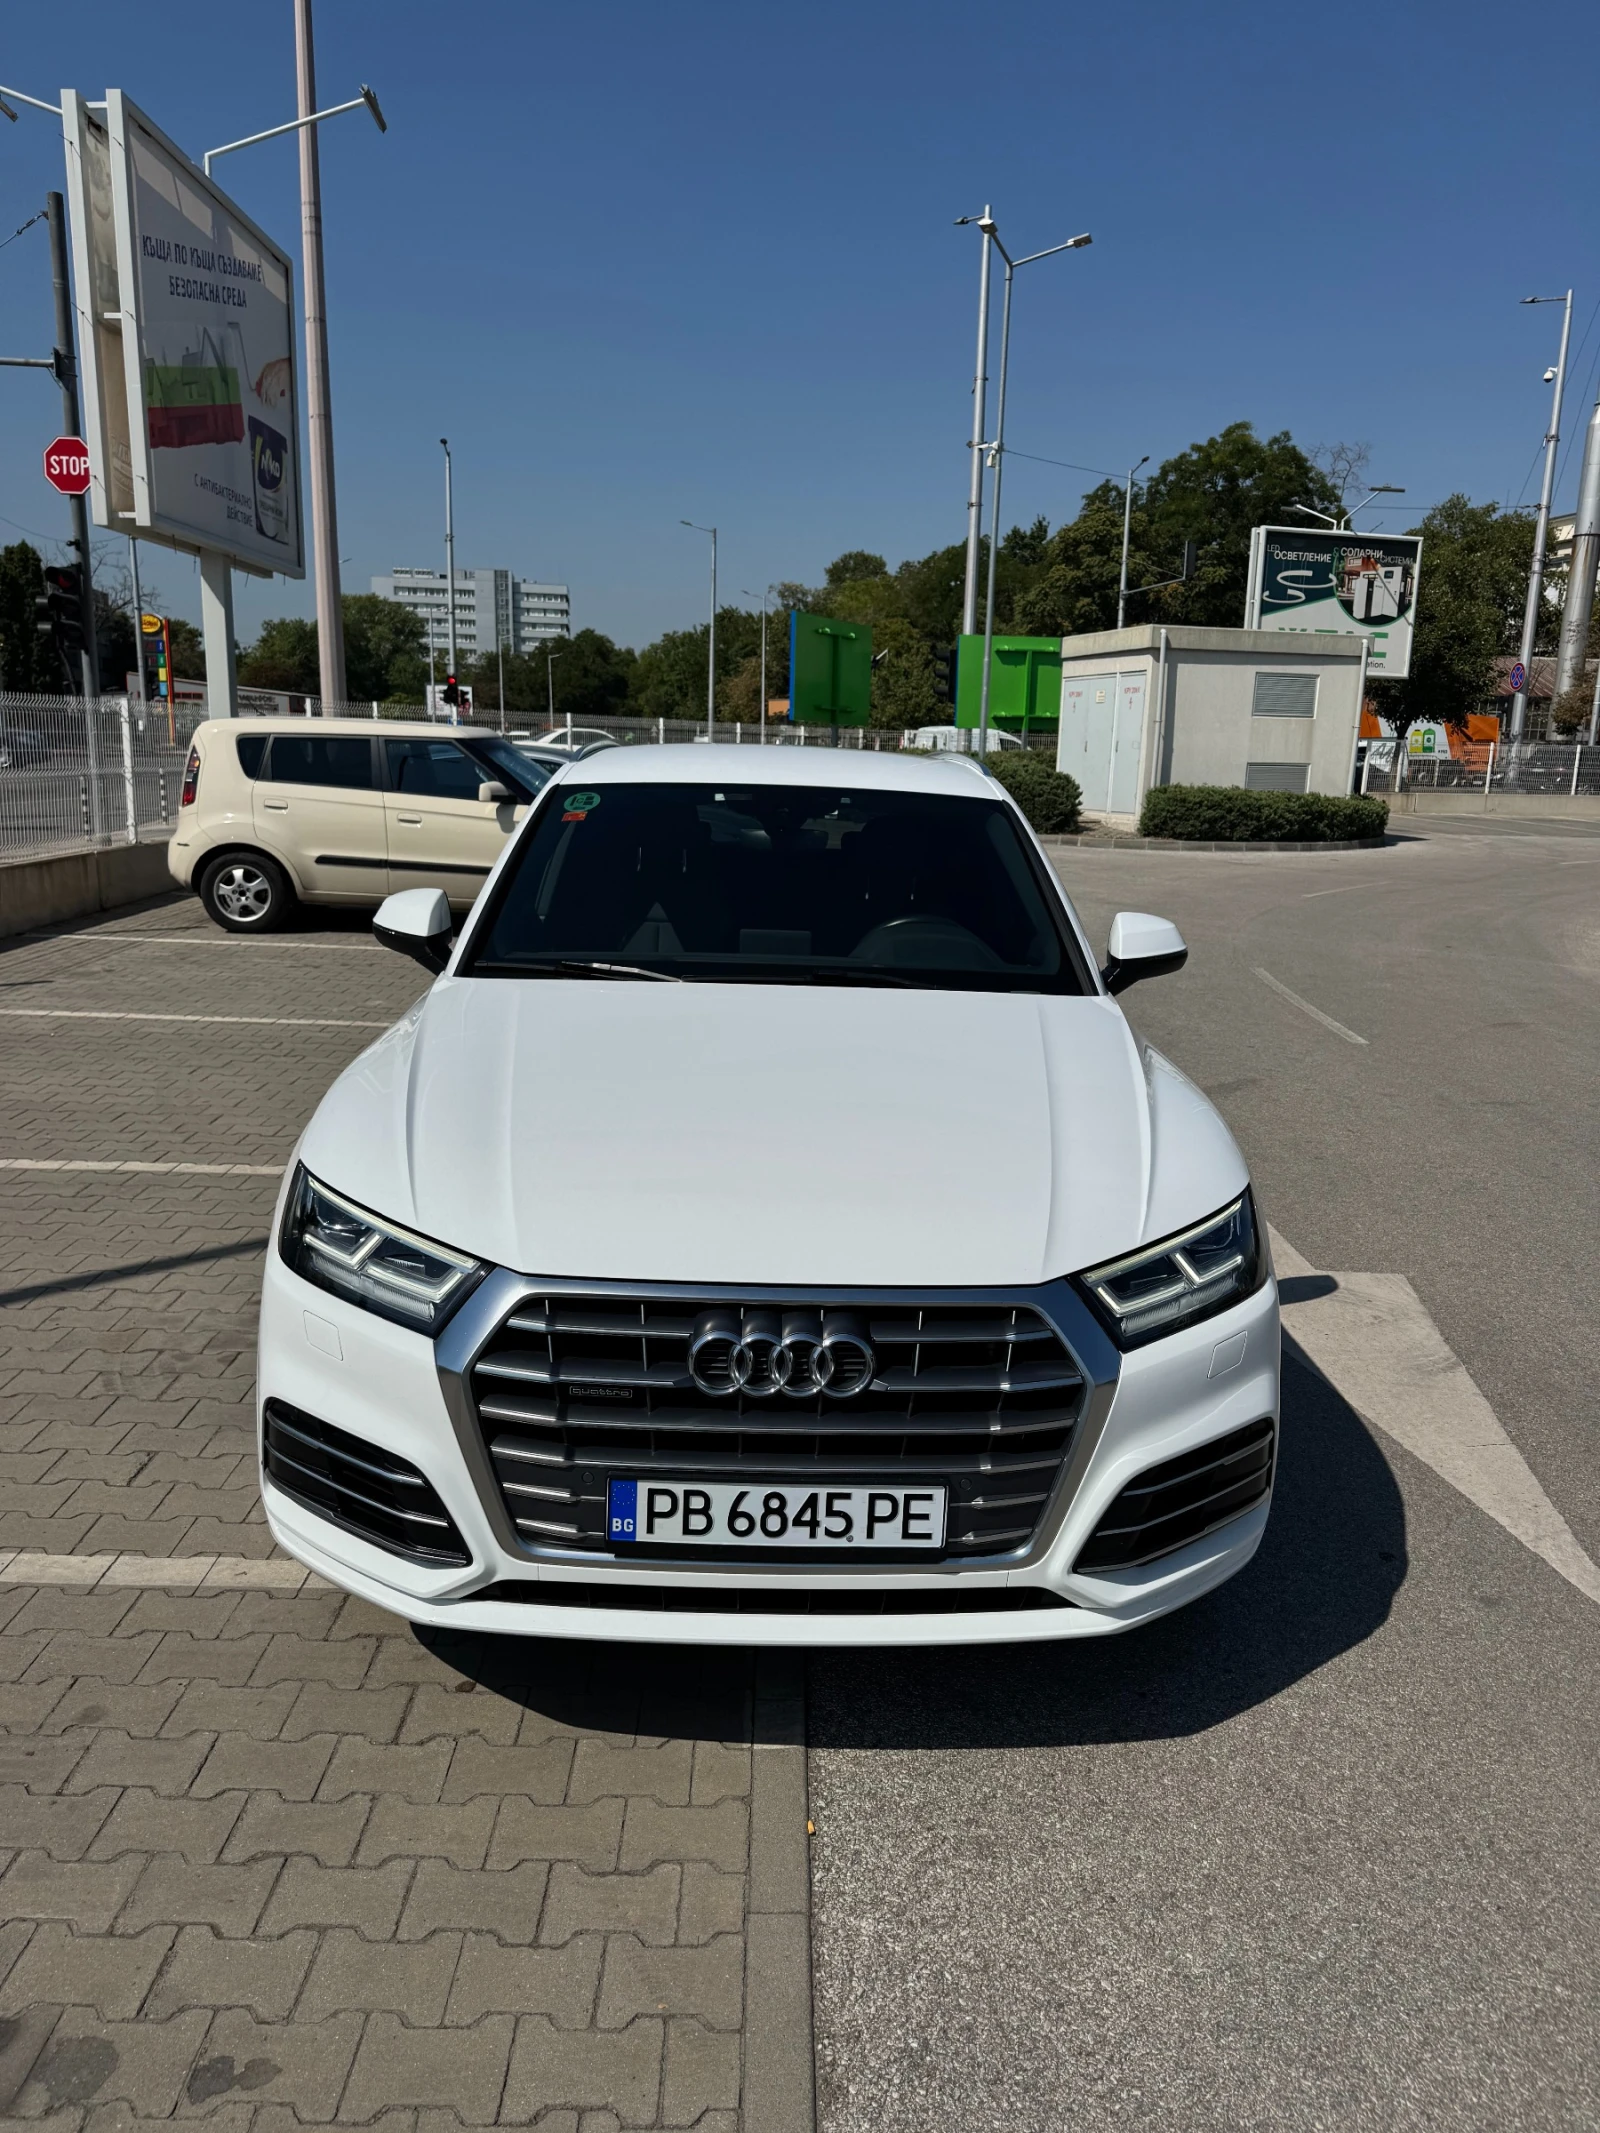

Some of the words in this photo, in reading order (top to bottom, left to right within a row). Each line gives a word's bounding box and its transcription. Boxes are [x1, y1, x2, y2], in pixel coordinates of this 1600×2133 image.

[142, 234, 172, 262] КЪЩА
[174, 243, 188, 265] ПО
[189, 246, 216, 273] КЪЩА
[217, 254, 262, 282] СЪЗДАВАМЕ
[168, 275, 221, 304] БЕЗОПАСНА
[222, 286, 247, 308] СРЕДА
[50, 455, 89, 476] STOP
[1267, 544, 1280, 552] LED
[1274, 550, 1332, 563] ОСВЕТЛЕНИЕ
[1341, 547, 1383, 559] СОЛАРНИ
[1380, 554, 1414, 566] СИСТЕМИ
[571, 1387, 630, 1396] quattro
[611, 1517, 634, 1532] BG
[645, 1487, 713, 1536] PB
[727, 1491, 854, 1539] 6845
[866, 1492, 935, 1540] PE
